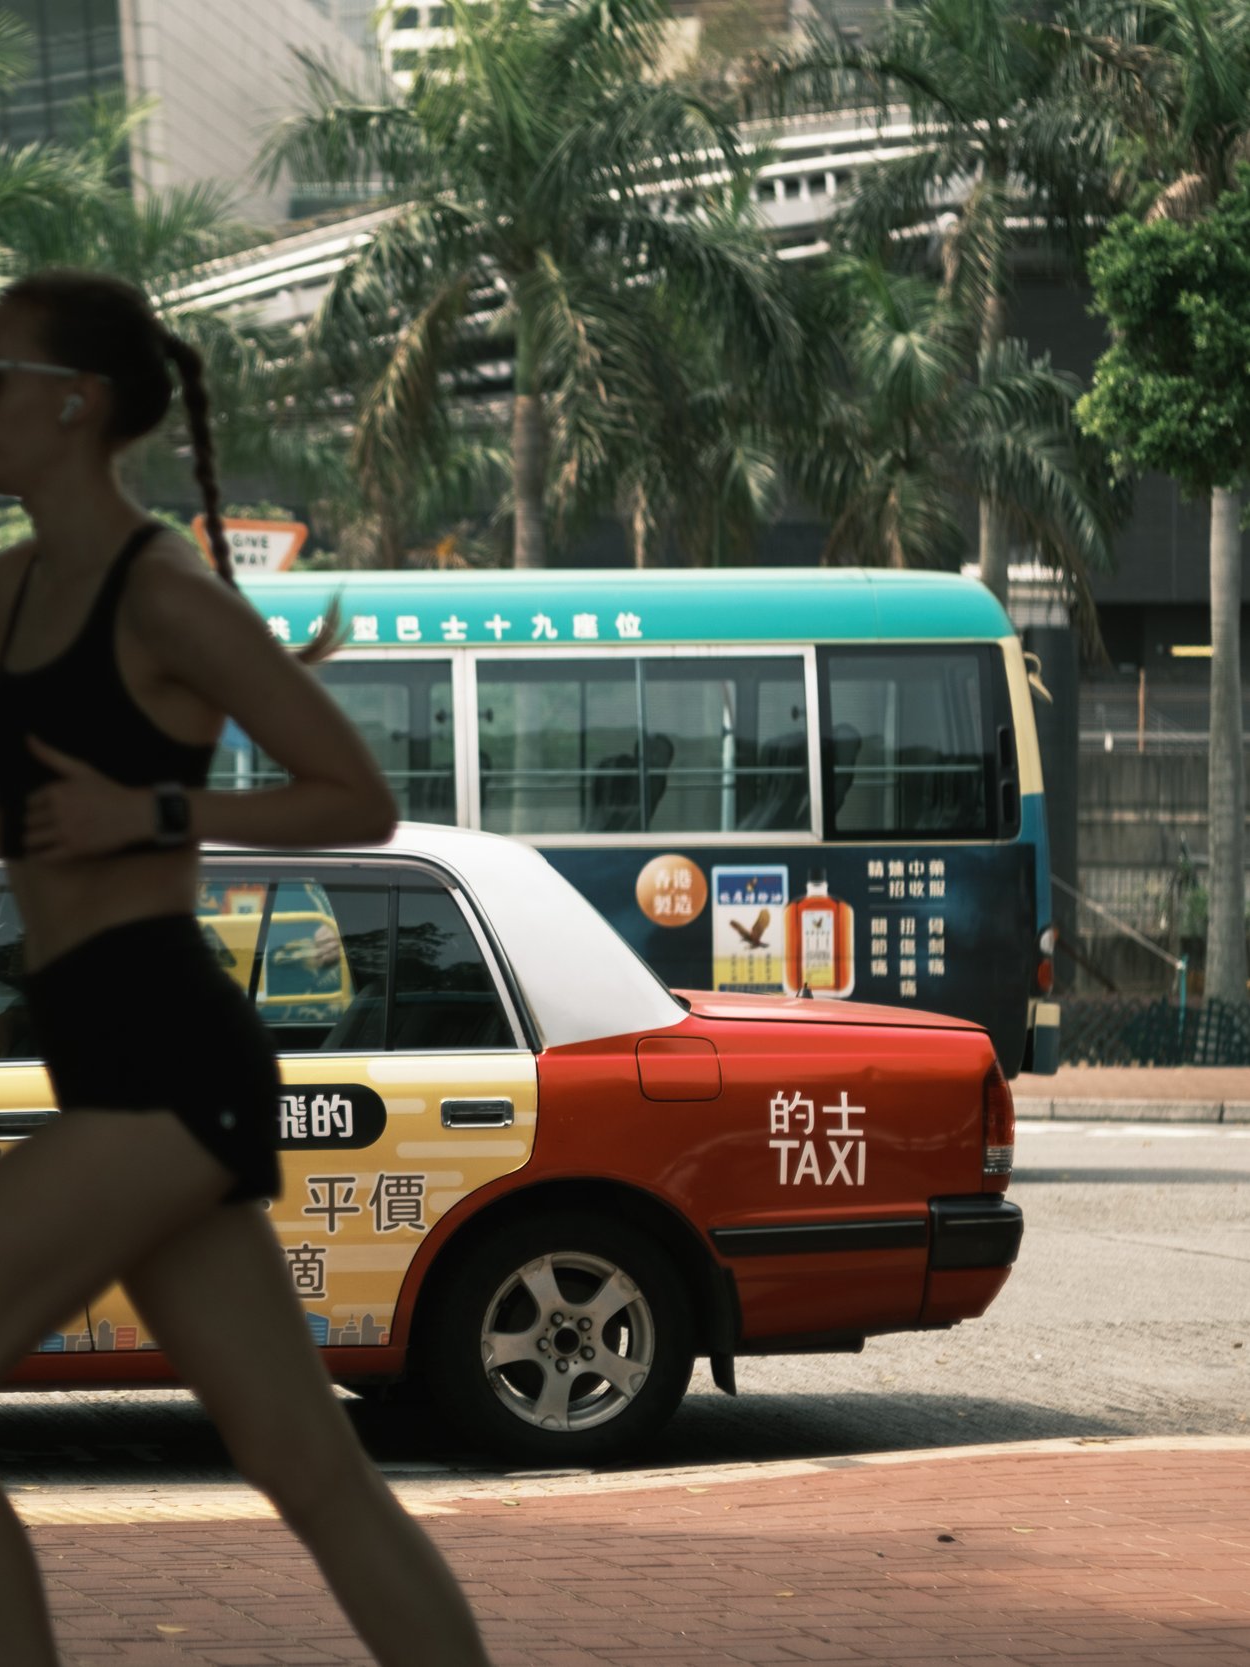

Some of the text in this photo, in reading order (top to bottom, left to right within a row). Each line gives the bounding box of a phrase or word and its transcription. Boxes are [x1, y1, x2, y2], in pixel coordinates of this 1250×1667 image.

[232, 533, 269, 549] GIVE
[234, 554, 267, 566] WAY
[770, 1091, 866, 1137] 的士
[769, 1140, 866, 1186] TAXI
[303, 1172, 427, 1233] 平價
